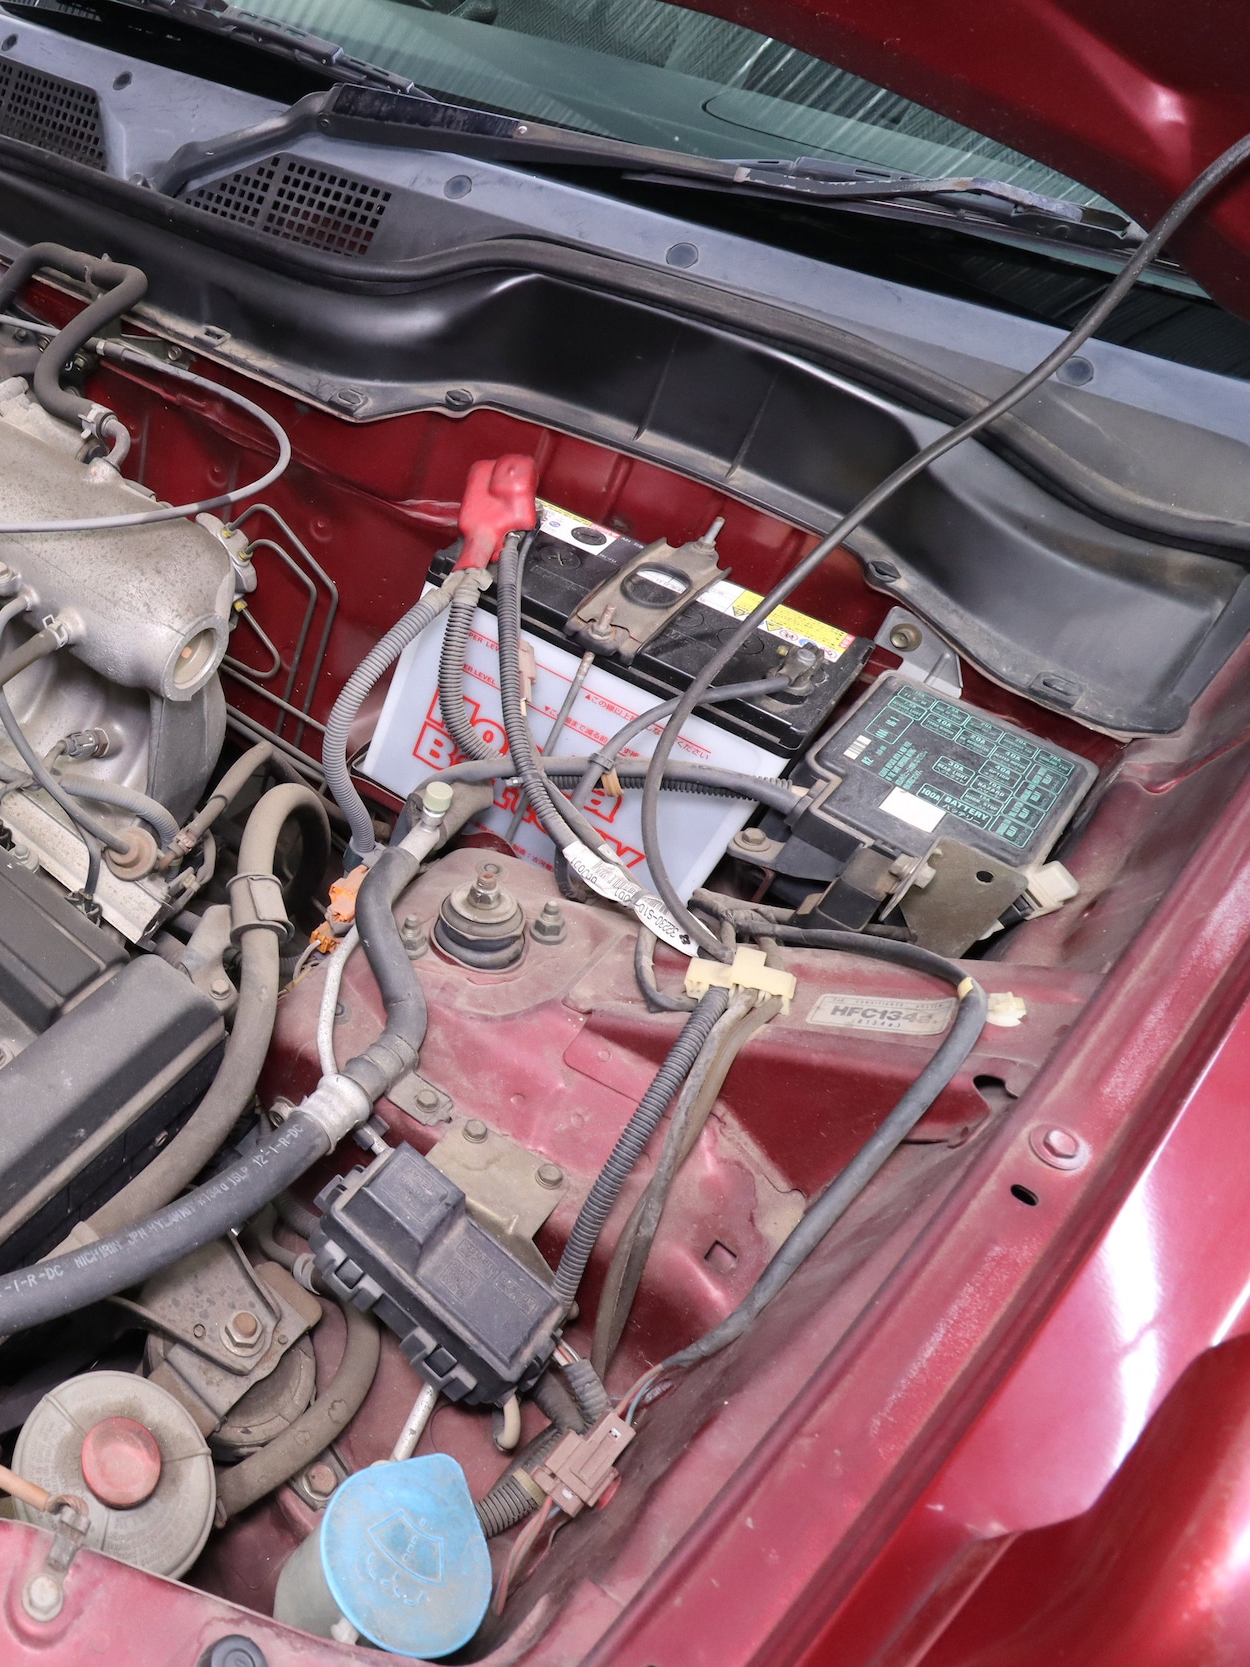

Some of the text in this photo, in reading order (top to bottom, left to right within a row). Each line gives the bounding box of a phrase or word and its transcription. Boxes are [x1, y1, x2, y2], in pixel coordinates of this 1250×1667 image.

[920, 787, 941, 801] 100A
[976, 781, 1005, 797] HAZARD
[943, 796, 989, 821] BATTERY
[74, 1240, 122, 1269] NICHIRIN
